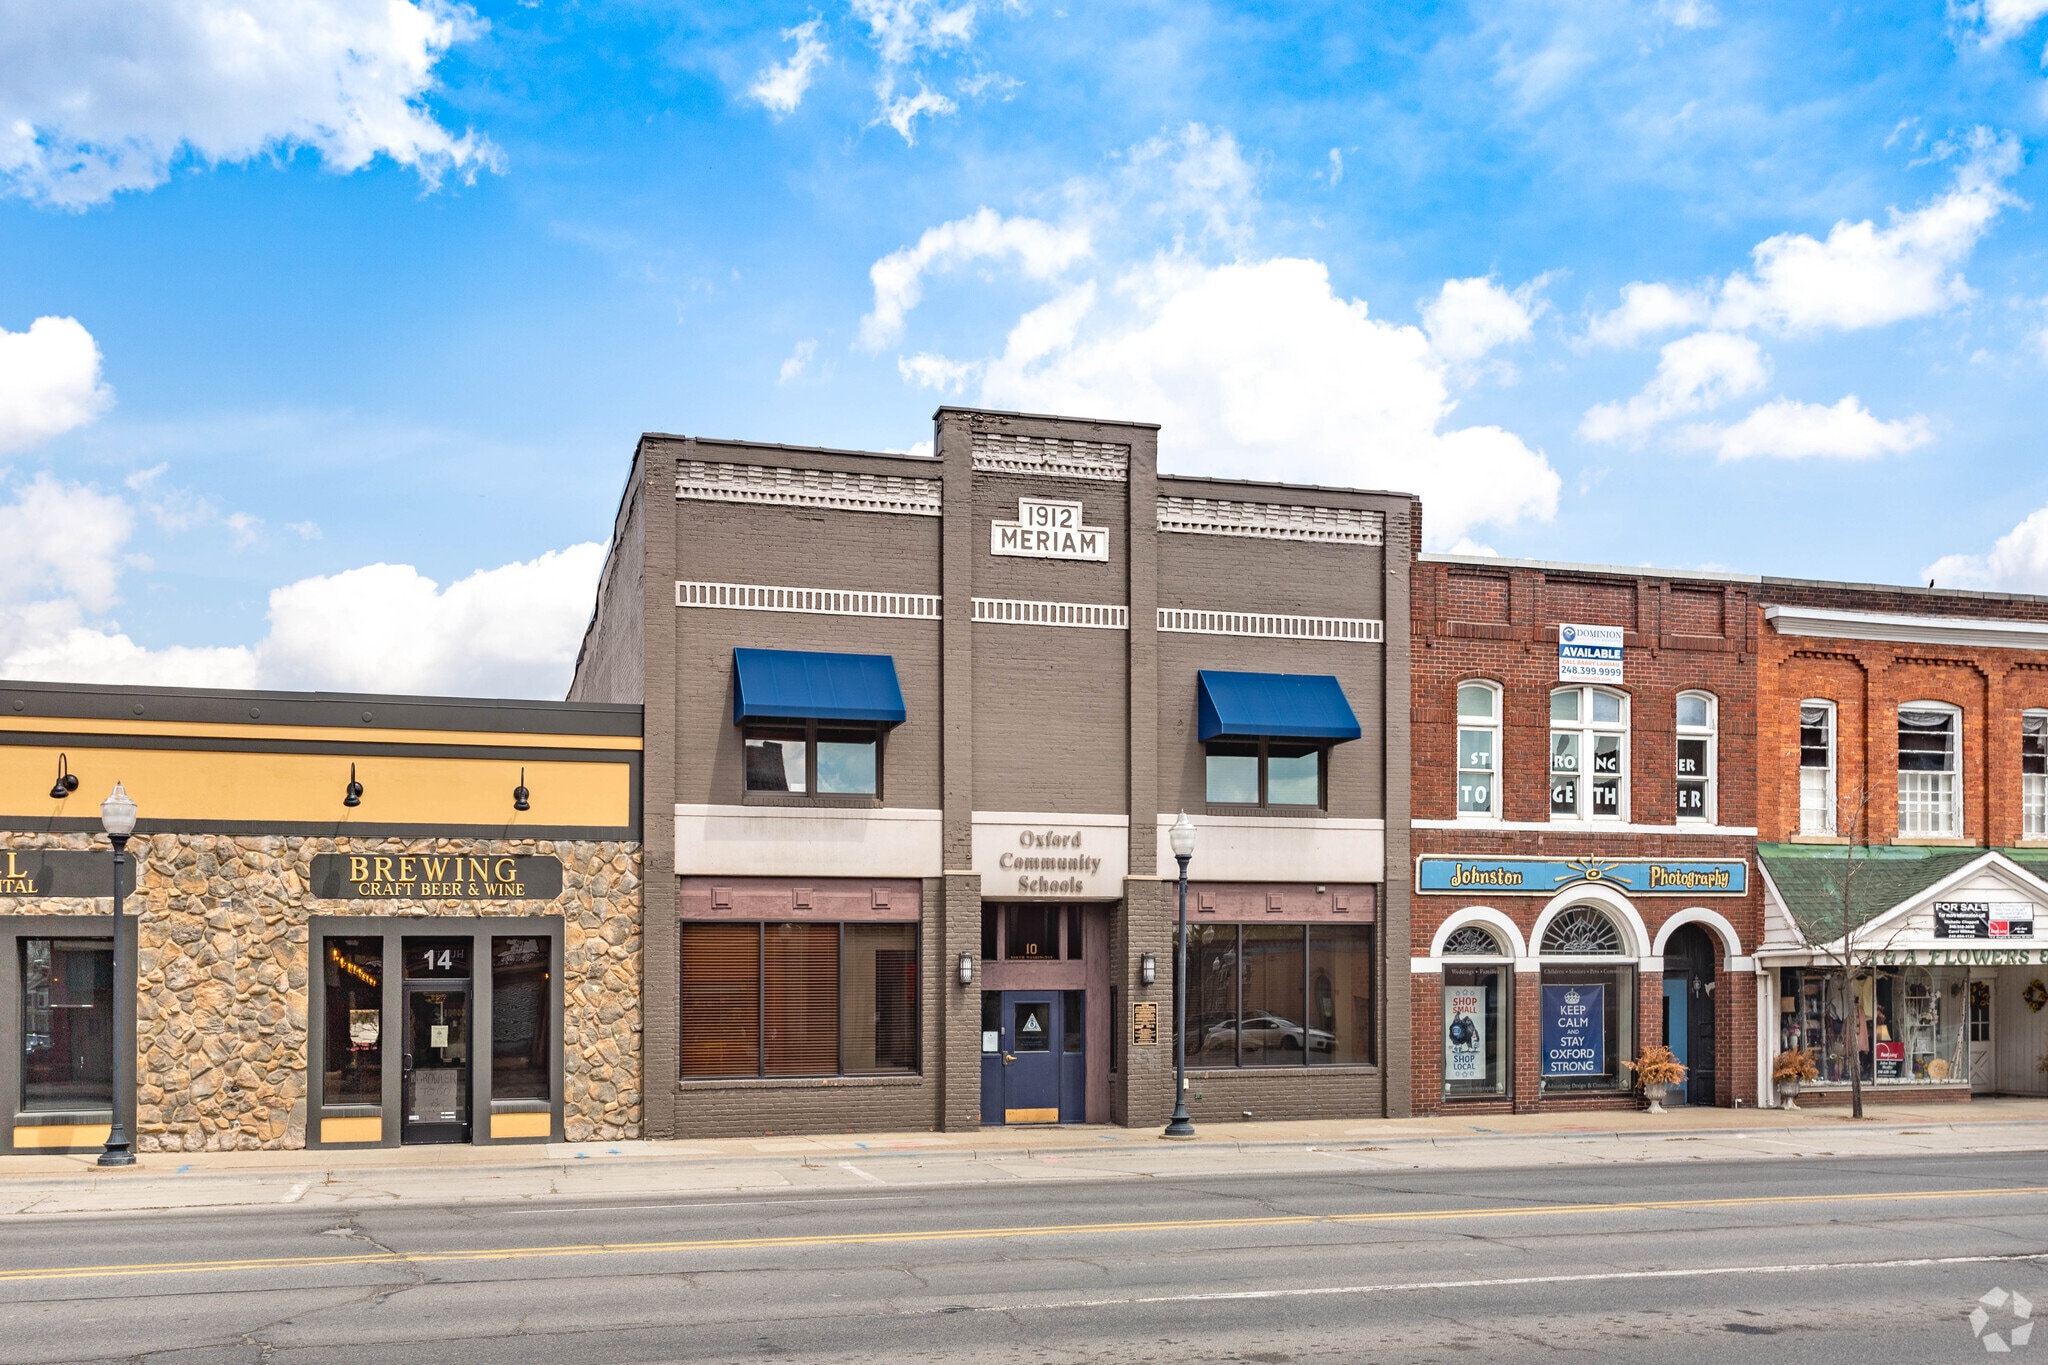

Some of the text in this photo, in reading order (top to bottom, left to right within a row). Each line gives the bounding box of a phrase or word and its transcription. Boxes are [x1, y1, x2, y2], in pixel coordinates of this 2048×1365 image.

[1029, 506, 1072, 528] 1912
[1002, 528, 1096, 553] MERIAM
[1577, 629, 1622, 639] DOMINION
[1562, 646, 1621, 659] AVAILABLE
[1561, 665, 1621, 677] 248.399.9999
[1019, 830, 1082, 848] Oxford
[0, 852, 28, 879] L
[350, 857, 517, 882] BREWING
[999, 852, 1101, 876] Community
[1451, 863, 1729, 888] Johnston Photography
[358, 882, 526, 896] CRAFT BEER & WINE
[1018, 875, 1083, 893] Schools
[1935, 903, 1958, 911] FOR
[1961, 903, 1988, 912] SALE
[1026, 943, 1037, 955] 10
[423, 949, 453, 970] 14
[1900, 949, 1918, 965] A
[1928, 949, 2030, 965] FLOWERS
[1452, 997, 1478, 1006] SHOP
[1452, 1006, 1477, 1014] SMALL
[1560, 1005, 1586, 1015] KEEP
[1557, 1017, 1589, 1028] CALM
[1560, 1036, 1585, 1047] STAY
[1453, 1055, 1475, 1063] SHOP
[1549, 1049, 1595, 1060] OXFORD
[1550, 1061, 1594, 1072] STRONG
